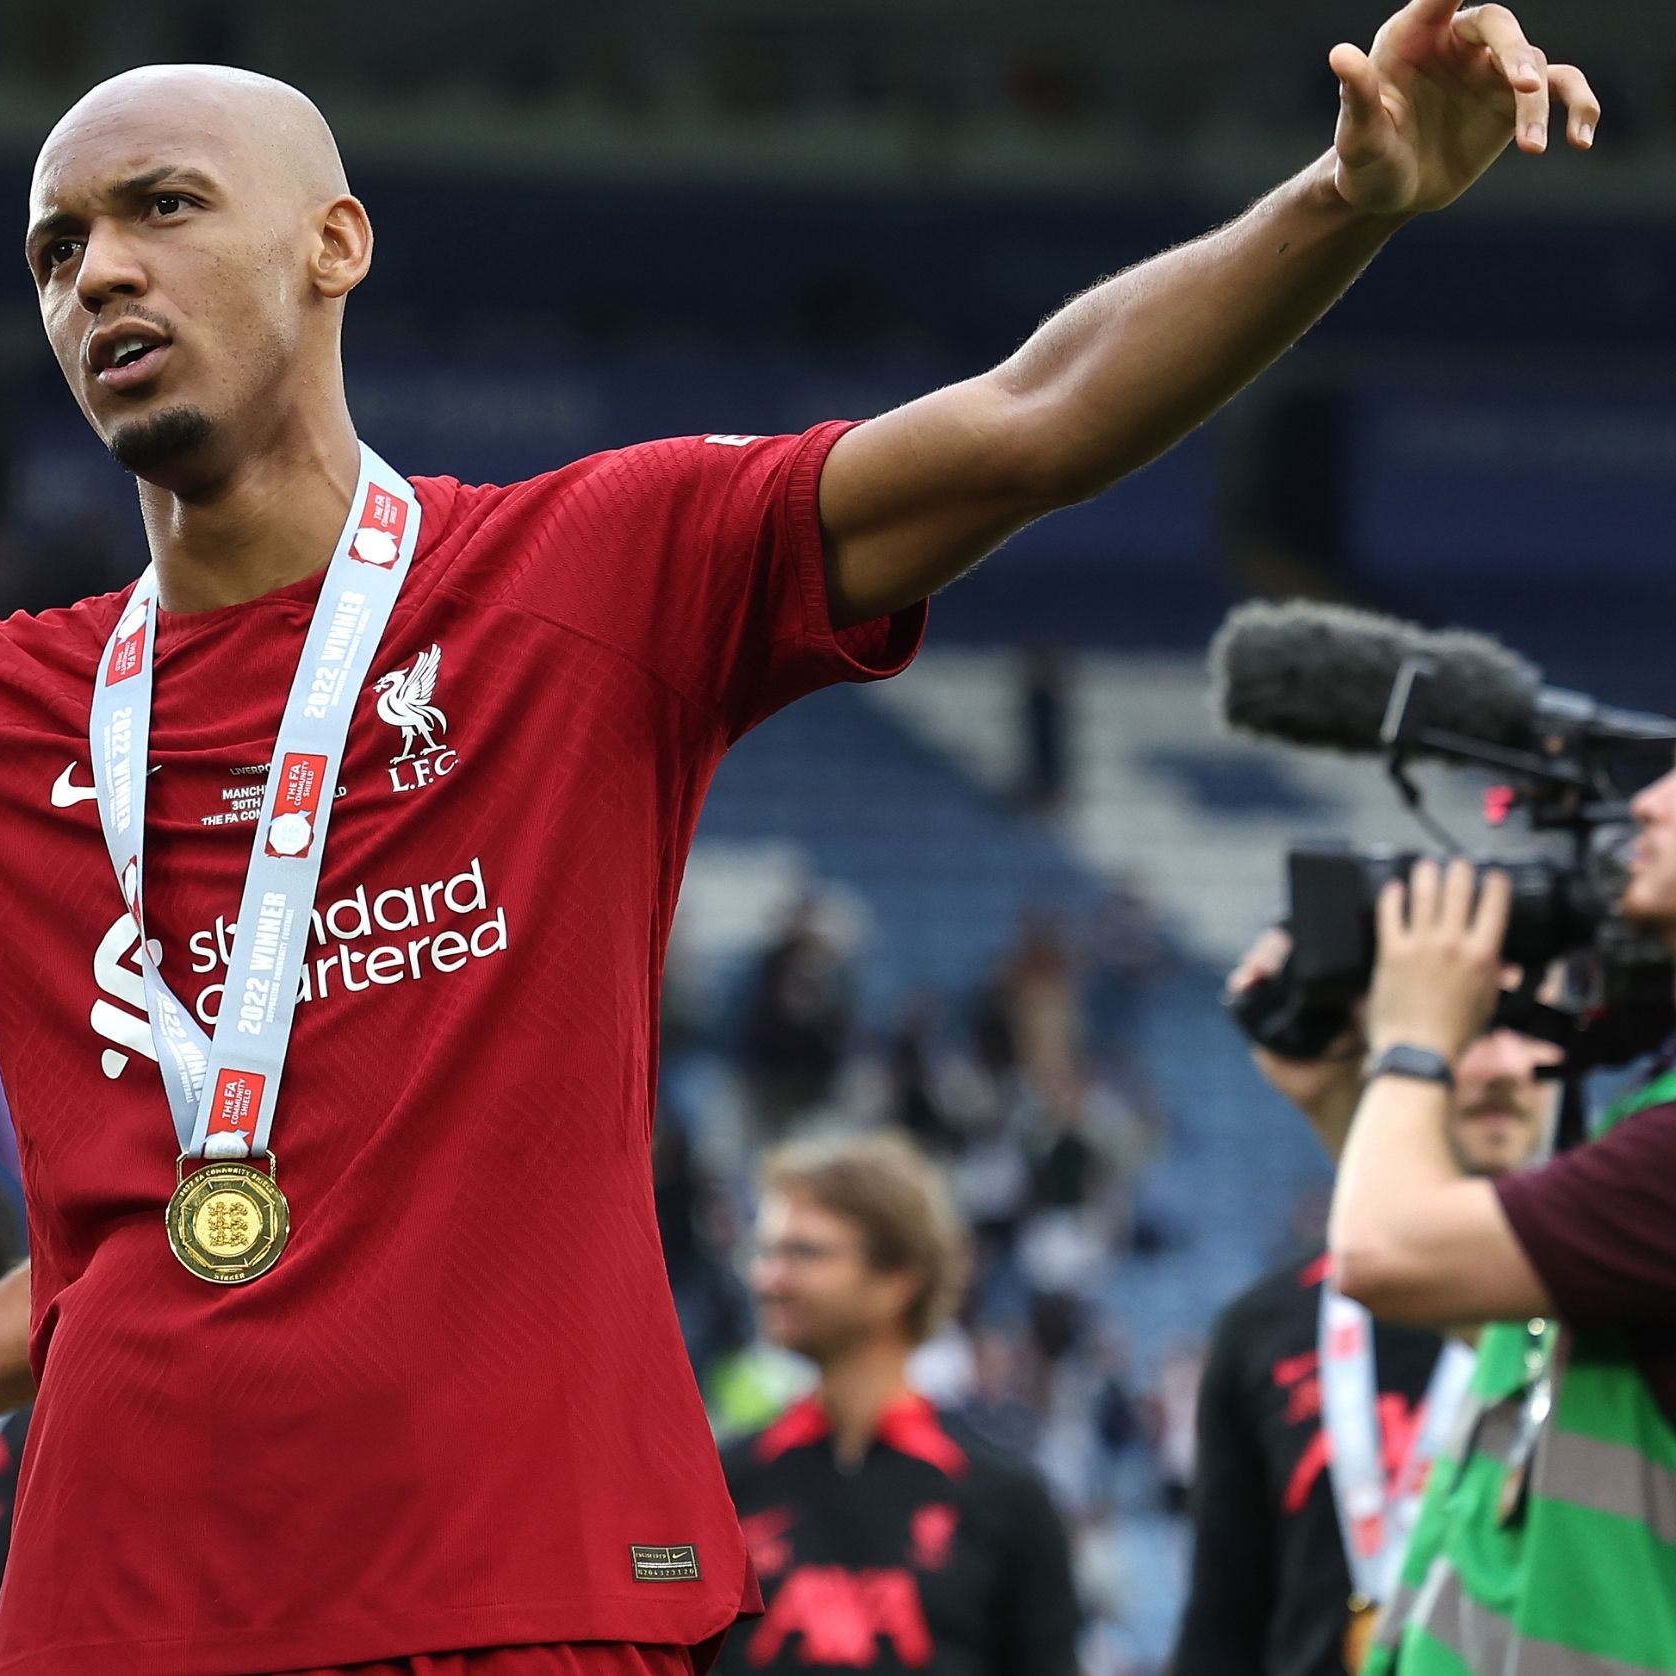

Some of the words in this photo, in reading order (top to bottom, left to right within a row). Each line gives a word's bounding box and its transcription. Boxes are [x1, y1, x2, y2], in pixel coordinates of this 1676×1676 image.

[303, 666, 339, 719] 2022
[321, 590, 366, 661] WINNER
[112, 706, 132, 759] 2022
[230, 763, 272, 776] LIVERPO
[289, 764, 302, 780] FA
[388, 750, 460, 792] L.F.C.
[112, 756, 131, 835] WINNER
[286, 782, 297, 801] THE
[294, 761, 309, 806] COMMUNITY
[303, 771, 314, 797] SHIELD
[232, 798, 261, 810] 30TH
[201, 815, 223, 826] THE
[224, 814, 238, 824] FA
[250, 892, 287, 971] WINNER
[237, 977, 270, 1035] 2022
[225, 1081, 238, 1098] FA
[231, 1078, 246, 1125] COMMUNITY
[240, 1088, 252, 1115] SHIELD
[222, 1099, 233, 1119] THE
